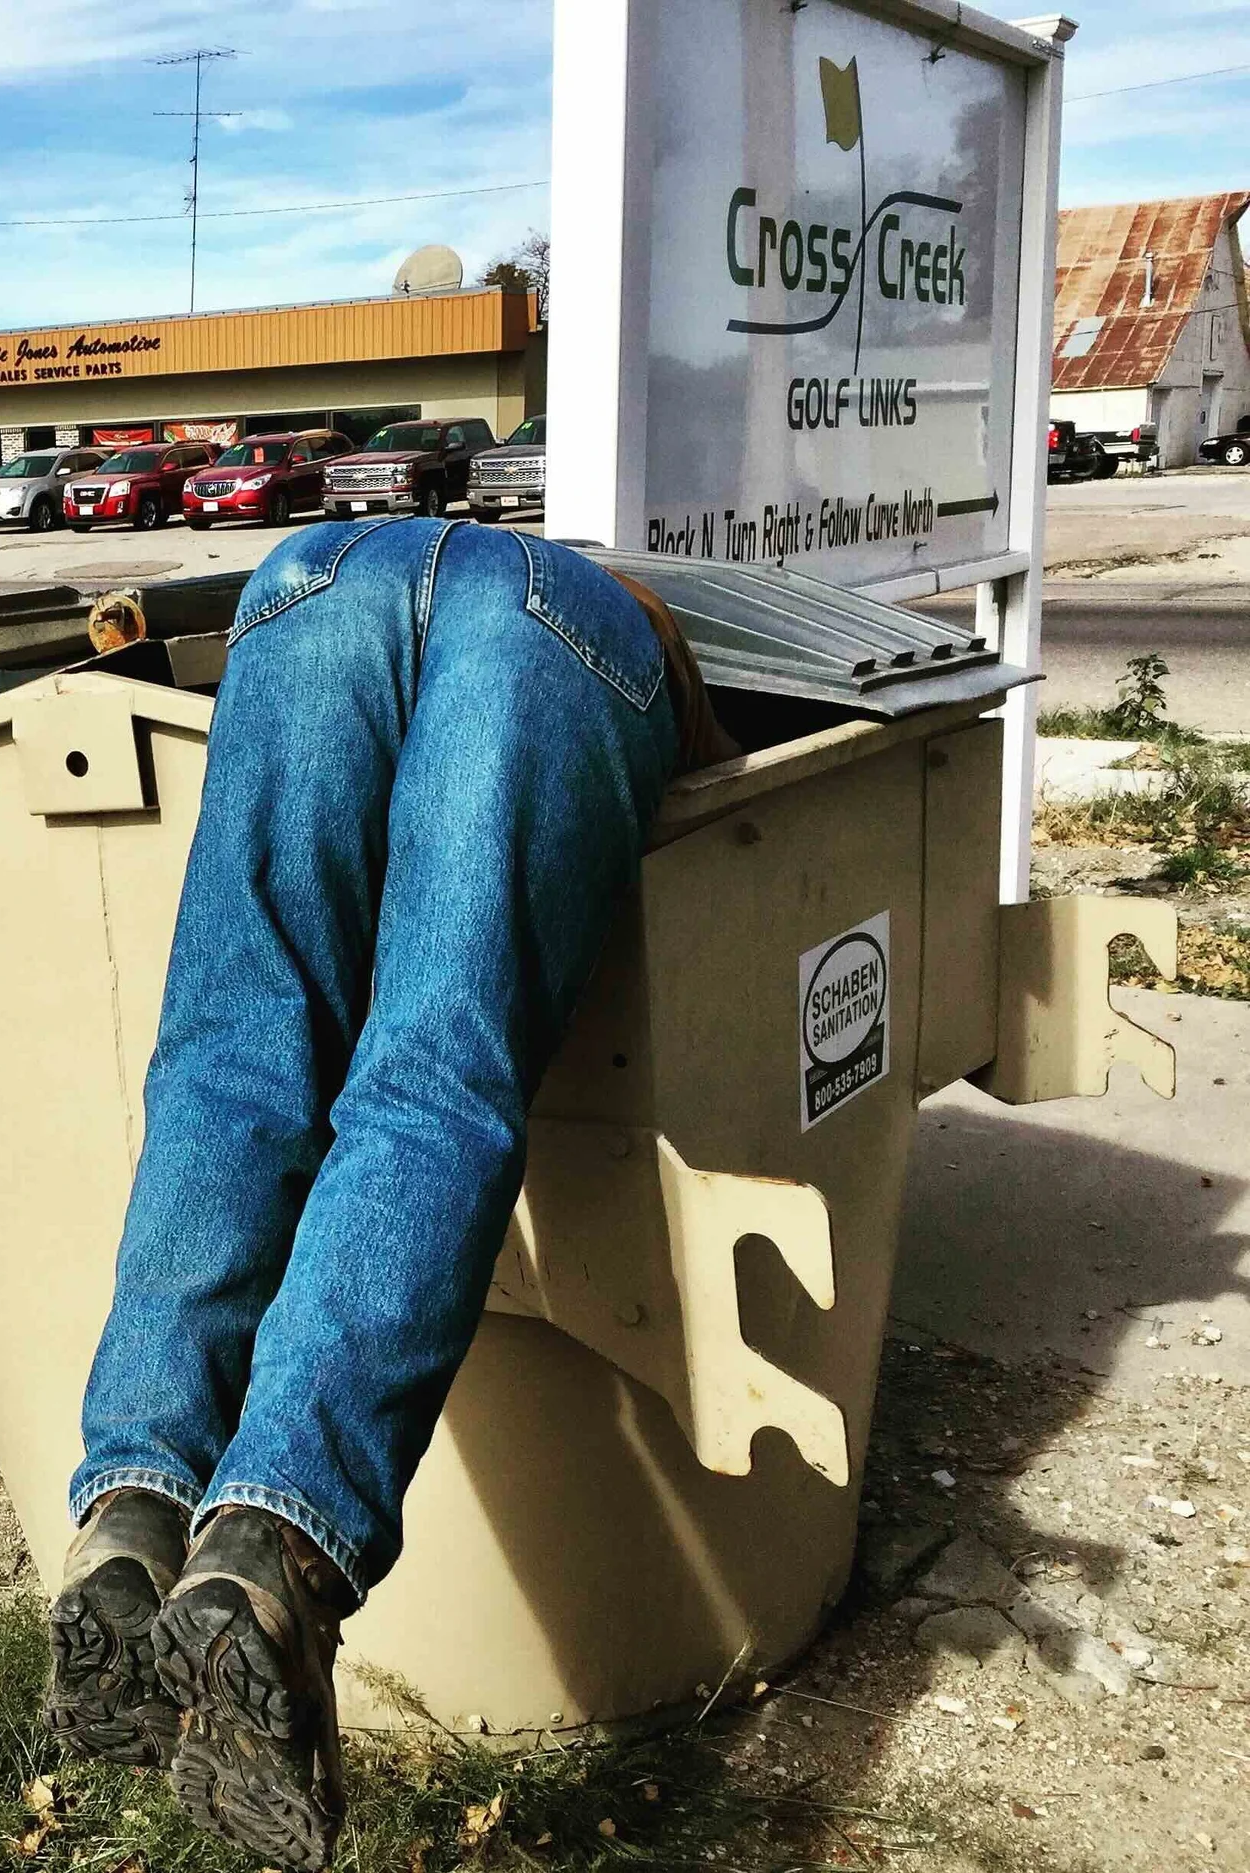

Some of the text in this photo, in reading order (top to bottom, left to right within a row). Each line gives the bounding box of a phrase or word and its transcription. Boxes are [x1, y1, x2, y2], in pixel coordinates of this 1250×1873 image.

[726, 187, 966, 306] Cross Creek
[14, 339, 58, 367] Jones
[65, 334, 161, 359] Automotive
[34, 365, 80, 380] SERVICE
[86, 362, 122, 377] PARTS
[787, 377, 917, 431] GOLF LINKS
[724, 509, 757, 563] Turn
[762, 502, 801, 567] Right
[805, 512, 814, 551] &
[818, 497, 862, 551] Follow
[865, 493, 900, 542] Curve
[902, 487, 934, 537] North
[811, 958, 879, 1021] SCHABEN
[812, 989, 879, 1048] SANITATION
[814, 1053, 878, 1112] 800-535-7909
